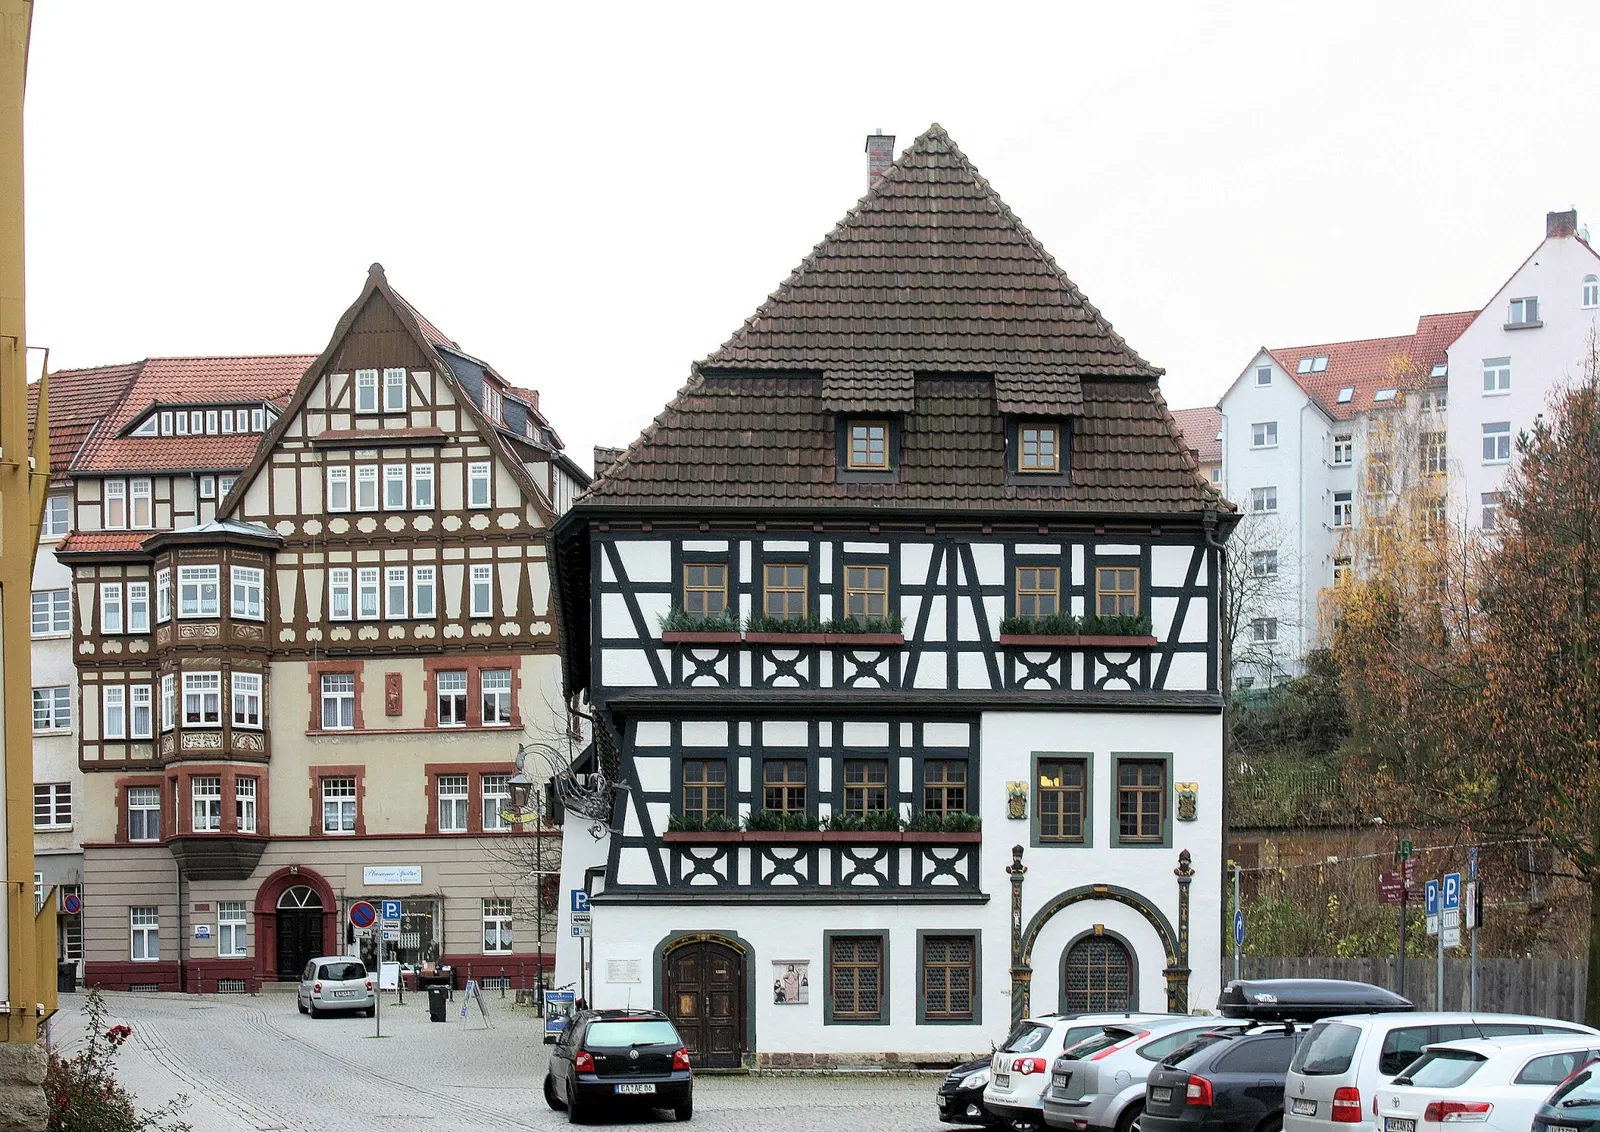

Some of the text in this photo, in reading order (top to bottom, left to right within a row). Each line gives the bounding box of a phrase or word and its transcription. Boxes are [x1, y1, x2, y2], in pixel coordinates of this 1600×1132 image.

[575, 891, 589, 910] P
[1428, 885, 1436, 912] P
[1446, 878, 1456, 905] P
[386, 902, 397, 918] P
